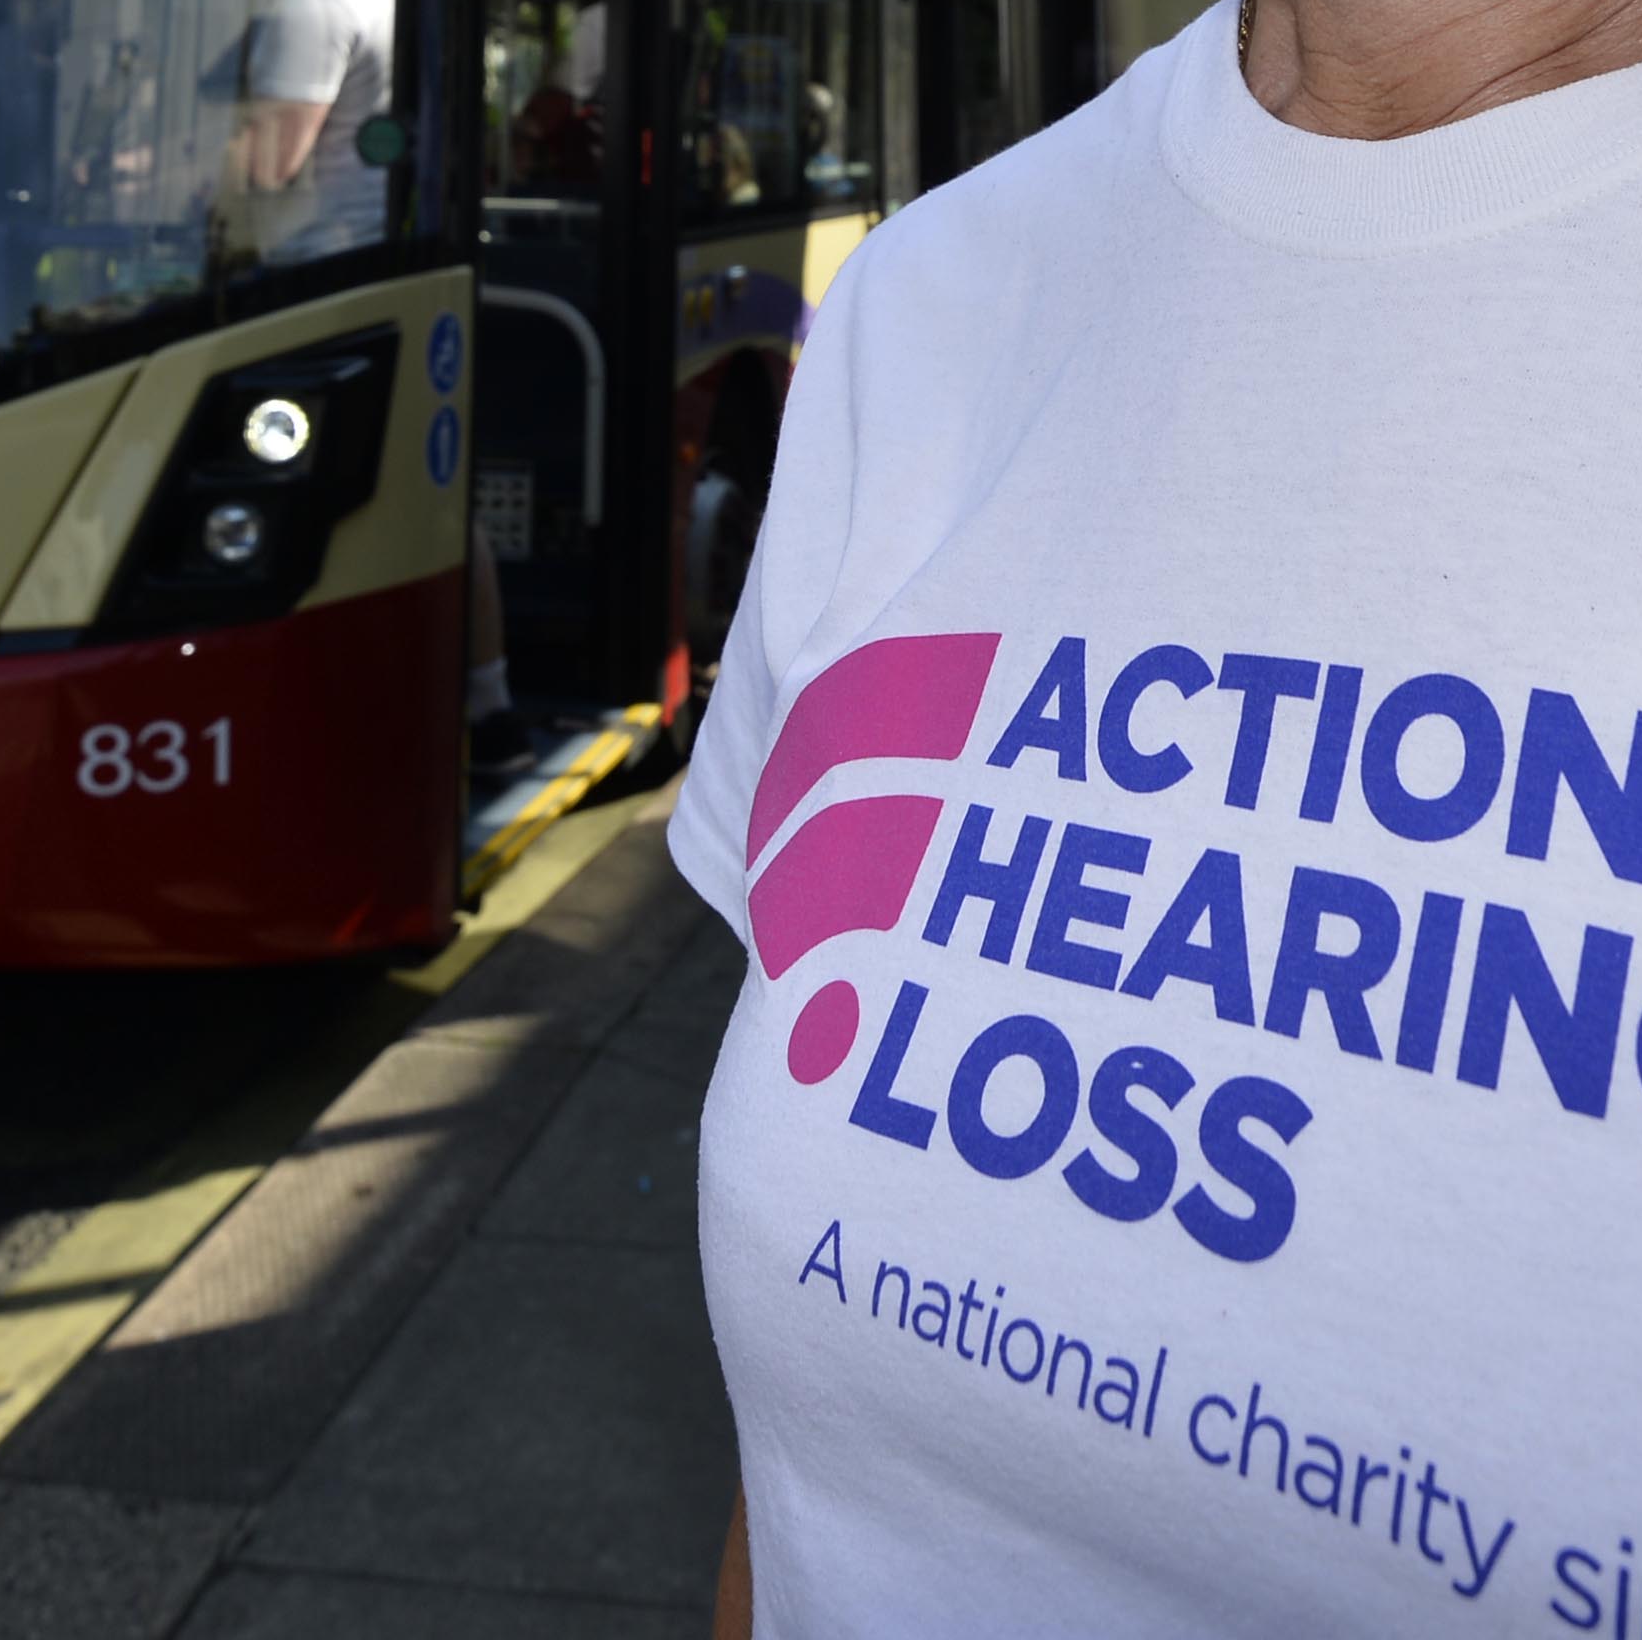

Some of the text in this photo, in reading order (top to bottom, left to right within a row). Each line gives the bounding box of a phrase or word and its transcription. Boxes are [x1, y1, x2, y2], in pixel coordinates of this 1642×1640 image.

[76, 717, 233, 798] 831
[847, 980, 1314, 1264] LOSS
[798, 1220, 849, 1304] A
[870, 1259, 1169, 1438] national
[1187, 1382, 1516, 1599] charity
